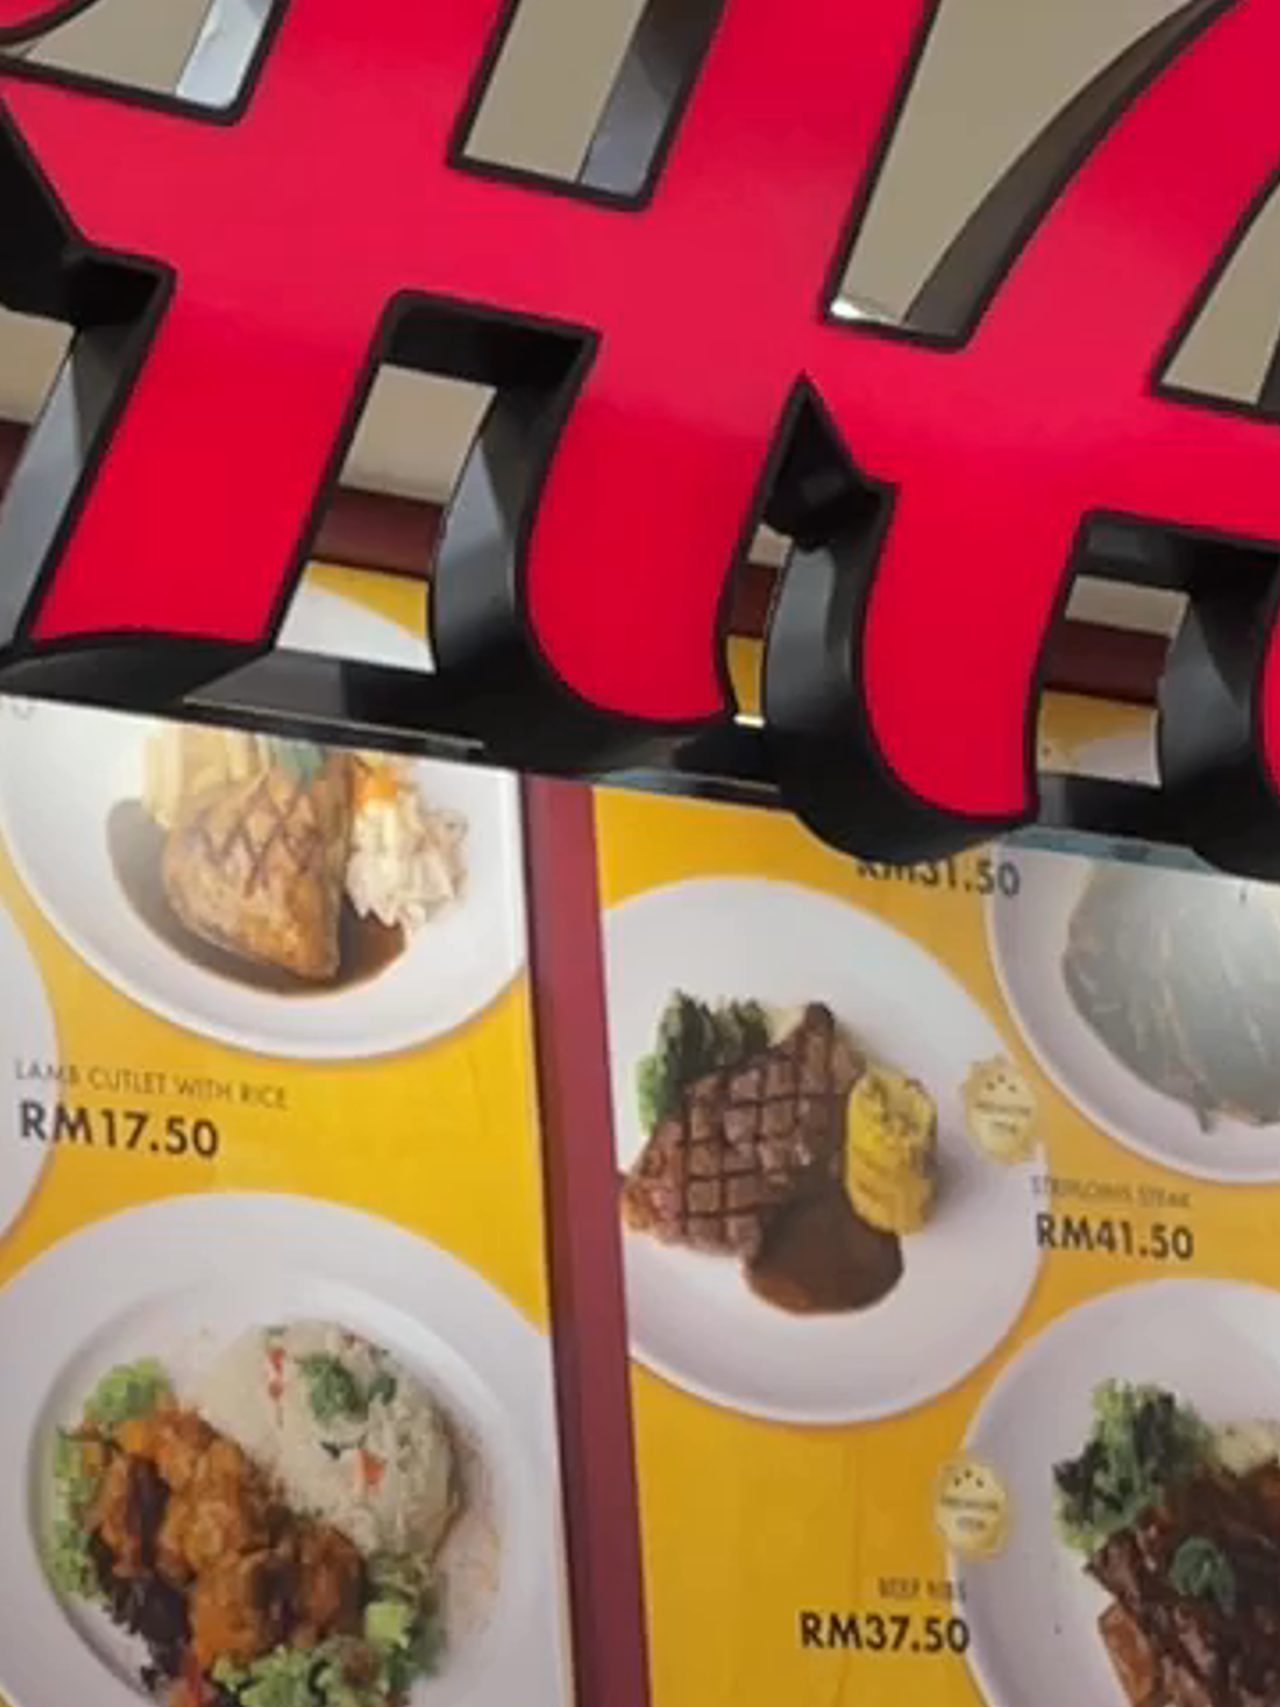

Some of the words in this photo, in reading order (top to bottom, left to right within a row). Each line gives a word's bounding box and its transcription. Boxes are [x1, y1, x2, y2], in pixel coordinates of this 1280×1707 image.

[15, 1059, 80, 1086] LAMB
[88, 1066, 166, 1095] CUTLET
[175, 1076, 231, 1102] WITH
[239, 1081, 289, 1109] RICE
[19, 1100, 220, 1159] RM17.50
[1036, 1213, 1195, 1261] RM41.50
[799, 1611, 971, 1654] RM37.50
